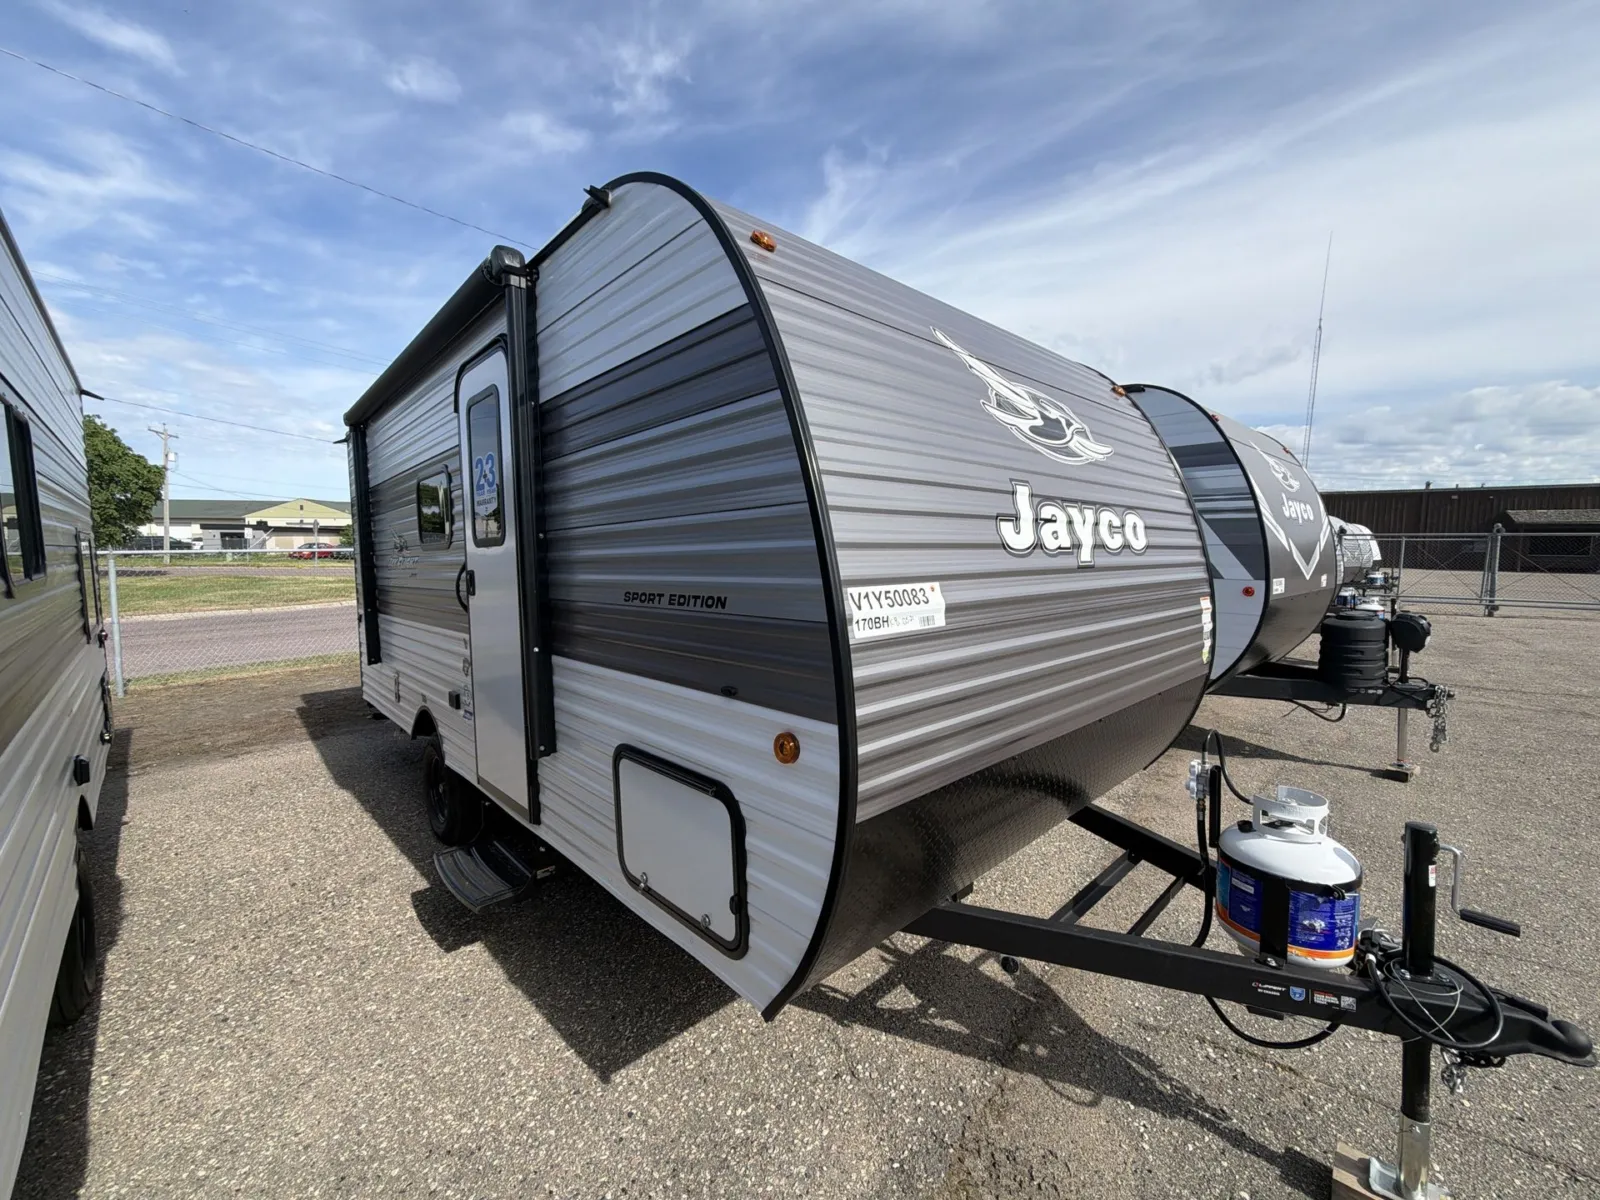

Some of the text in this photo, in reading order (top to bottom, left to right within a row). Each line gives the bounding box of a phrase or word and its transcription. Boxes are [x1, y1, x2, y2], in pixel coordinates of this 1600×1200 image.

[1281, 492, 1314, 525] Jayco
[996, 479, 1149, 568] Jayco
[623, 591, 728, 610] SPORT EDITION
[849, 587, 930, 611] V1Y50083
[854, 615, 890, 632] 170BH
